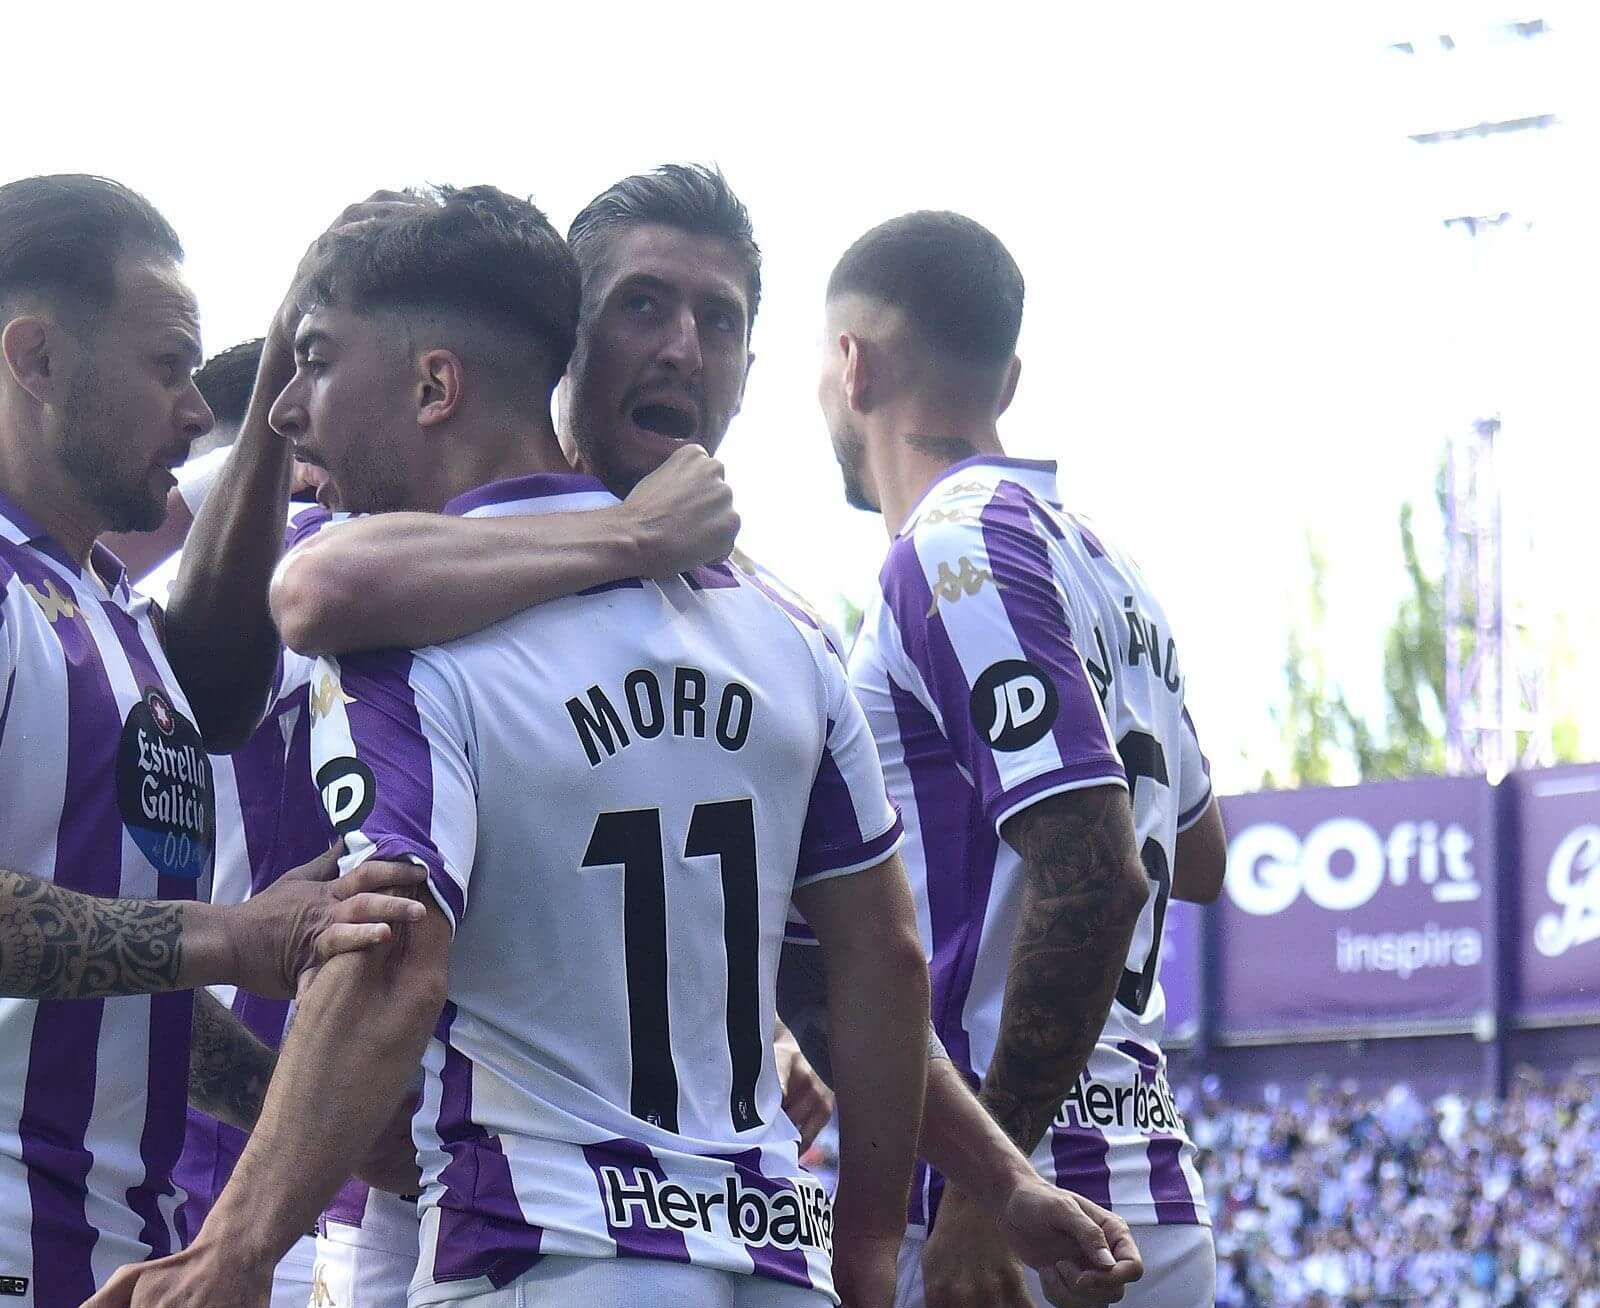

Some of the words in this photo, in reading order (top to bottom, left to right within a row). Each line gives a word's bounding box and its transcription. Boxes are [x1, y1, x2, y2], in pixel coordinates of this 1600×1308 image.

[565, 667, 753, 767] MORO
[989, 675, 1046, 742] JD
[137, 727, 206, 790] Estrella
[141, 774, 204, 833] Galicia
[581, 799, 764, 1131] 11
[1336, 922, 1482, 980] inspira
